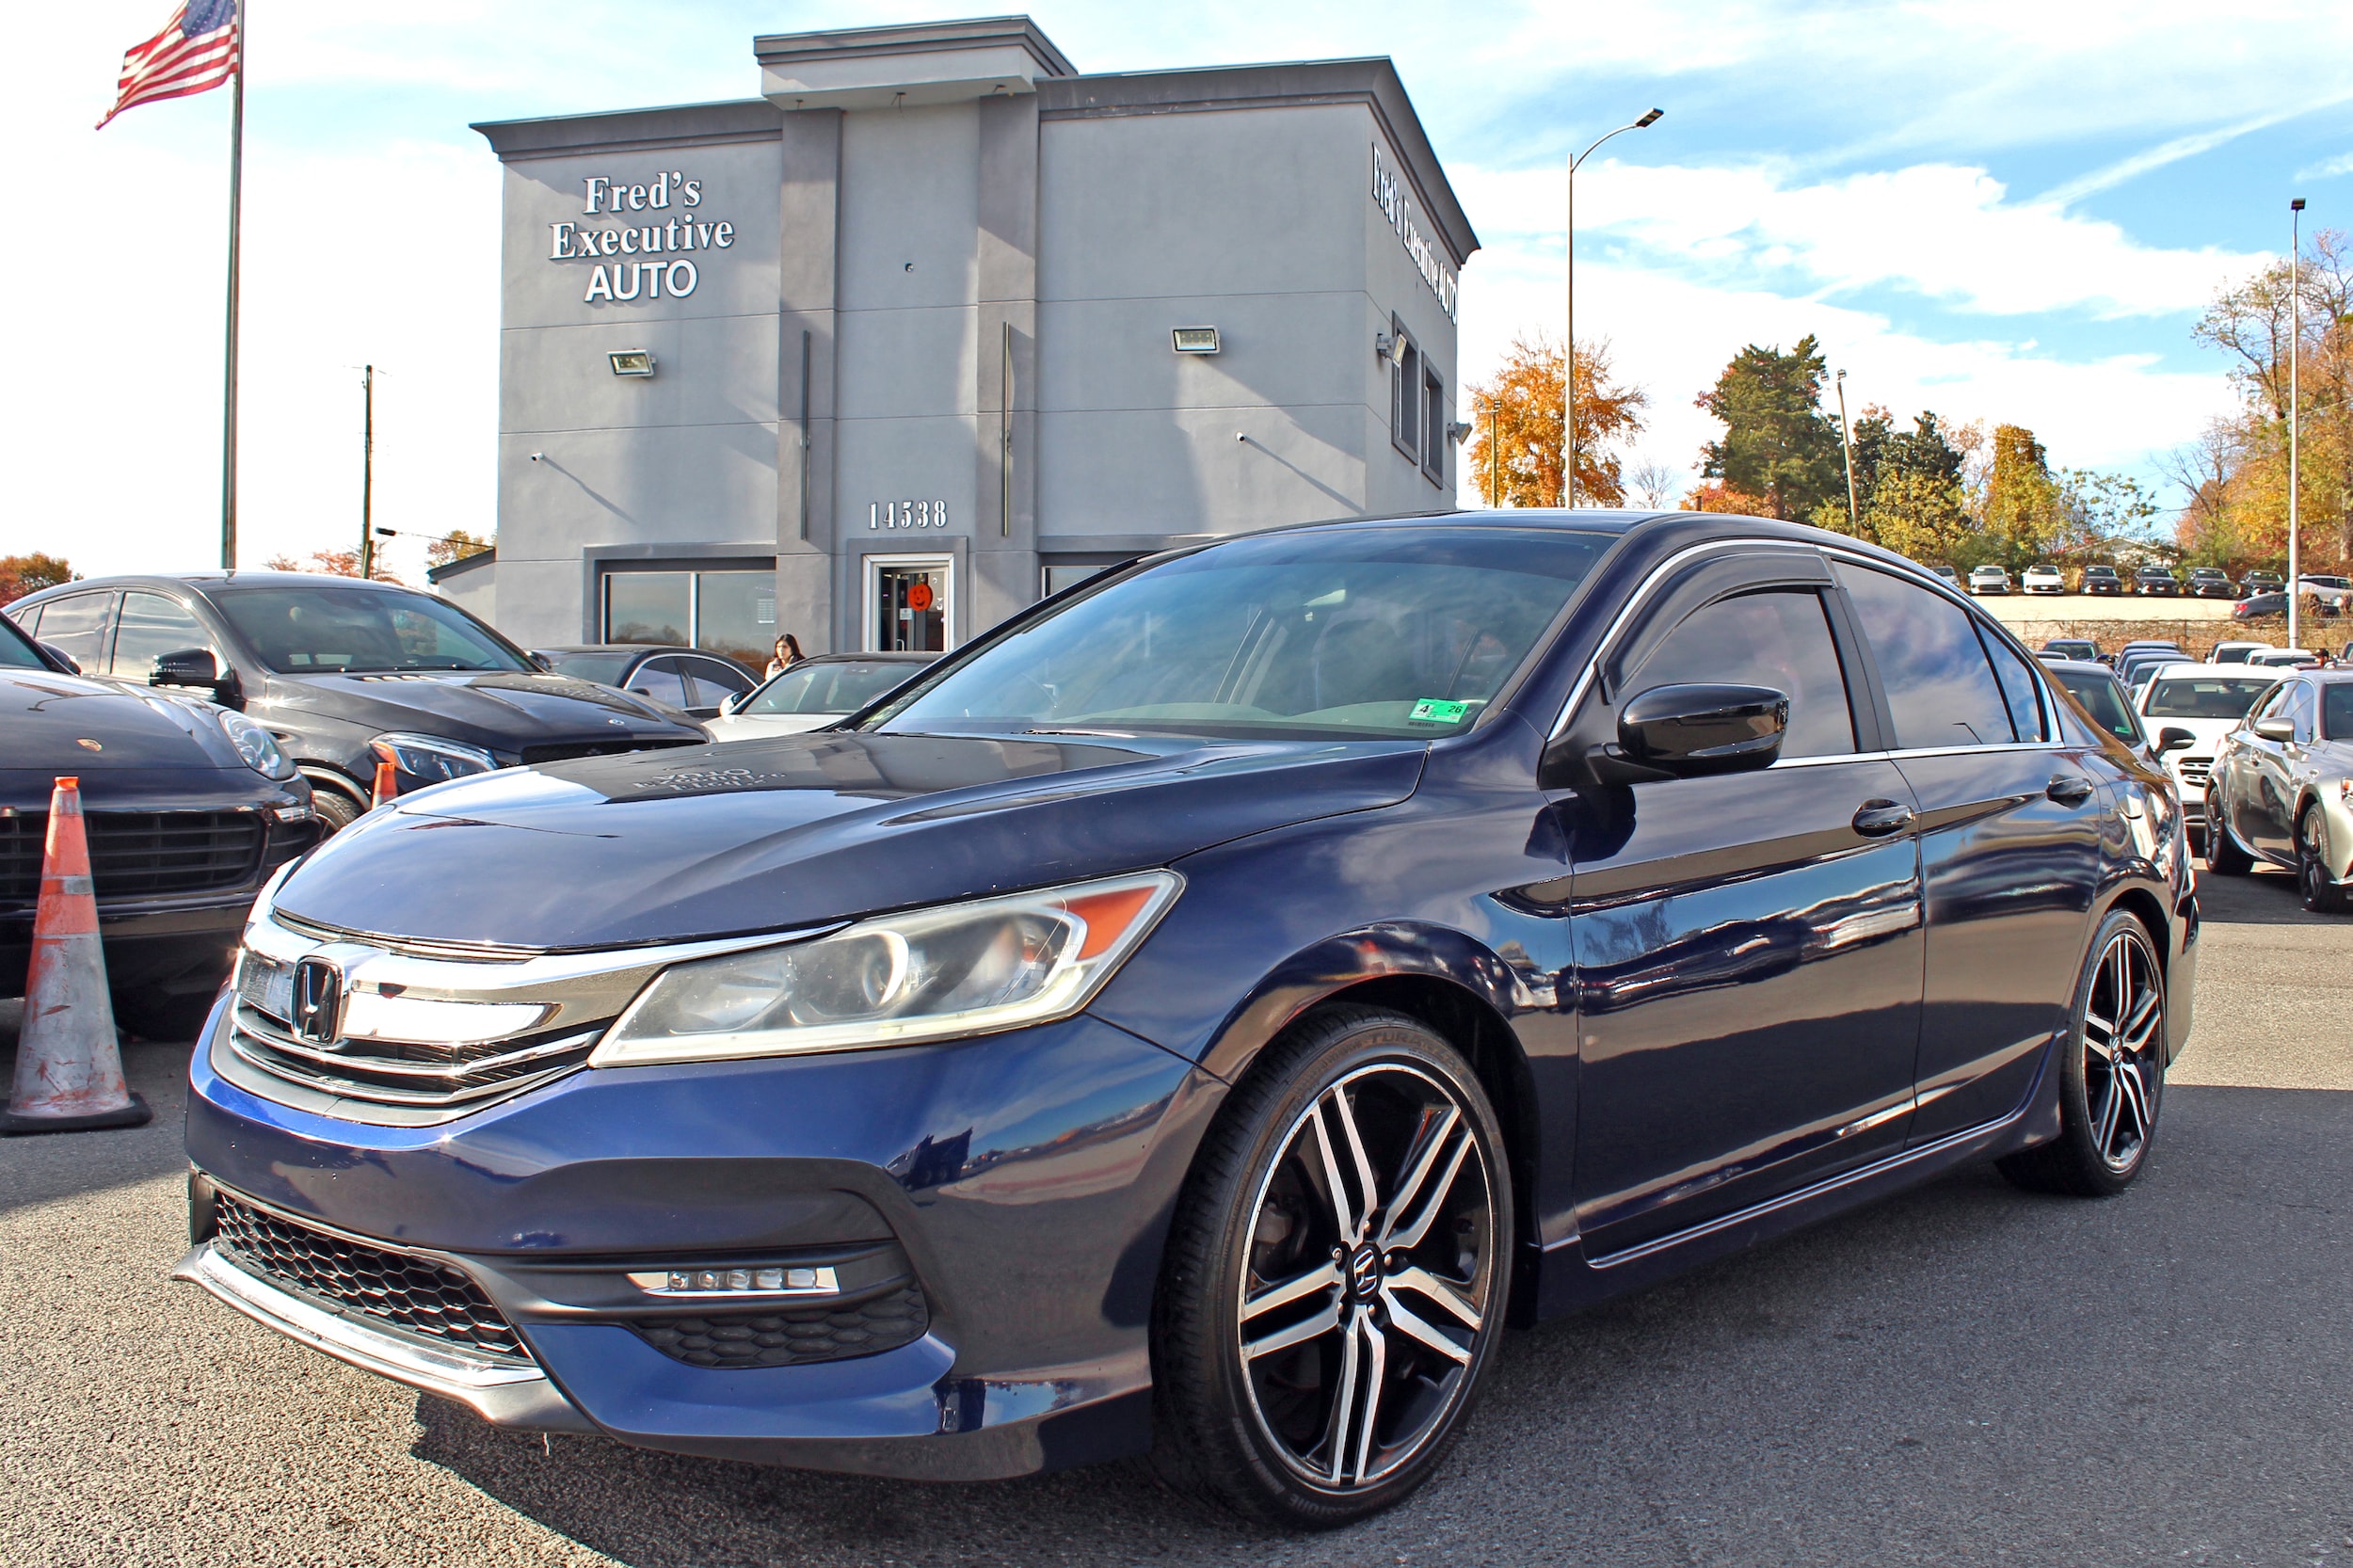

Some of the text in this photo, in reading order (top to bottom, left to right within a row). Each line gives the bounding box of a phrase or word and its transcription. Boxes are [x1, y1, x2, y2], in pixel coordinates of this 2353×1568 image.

[583, 170, 702, 215] Fred's
[549, 214, 734, 260] Executive
[1371, 143, 1459, 326] Fred's Executive AUTO
[584, 259, 699, 302] AUTO
[869, 501, 948, 529] 14538
[1448, 705, 1463, 713] 26
